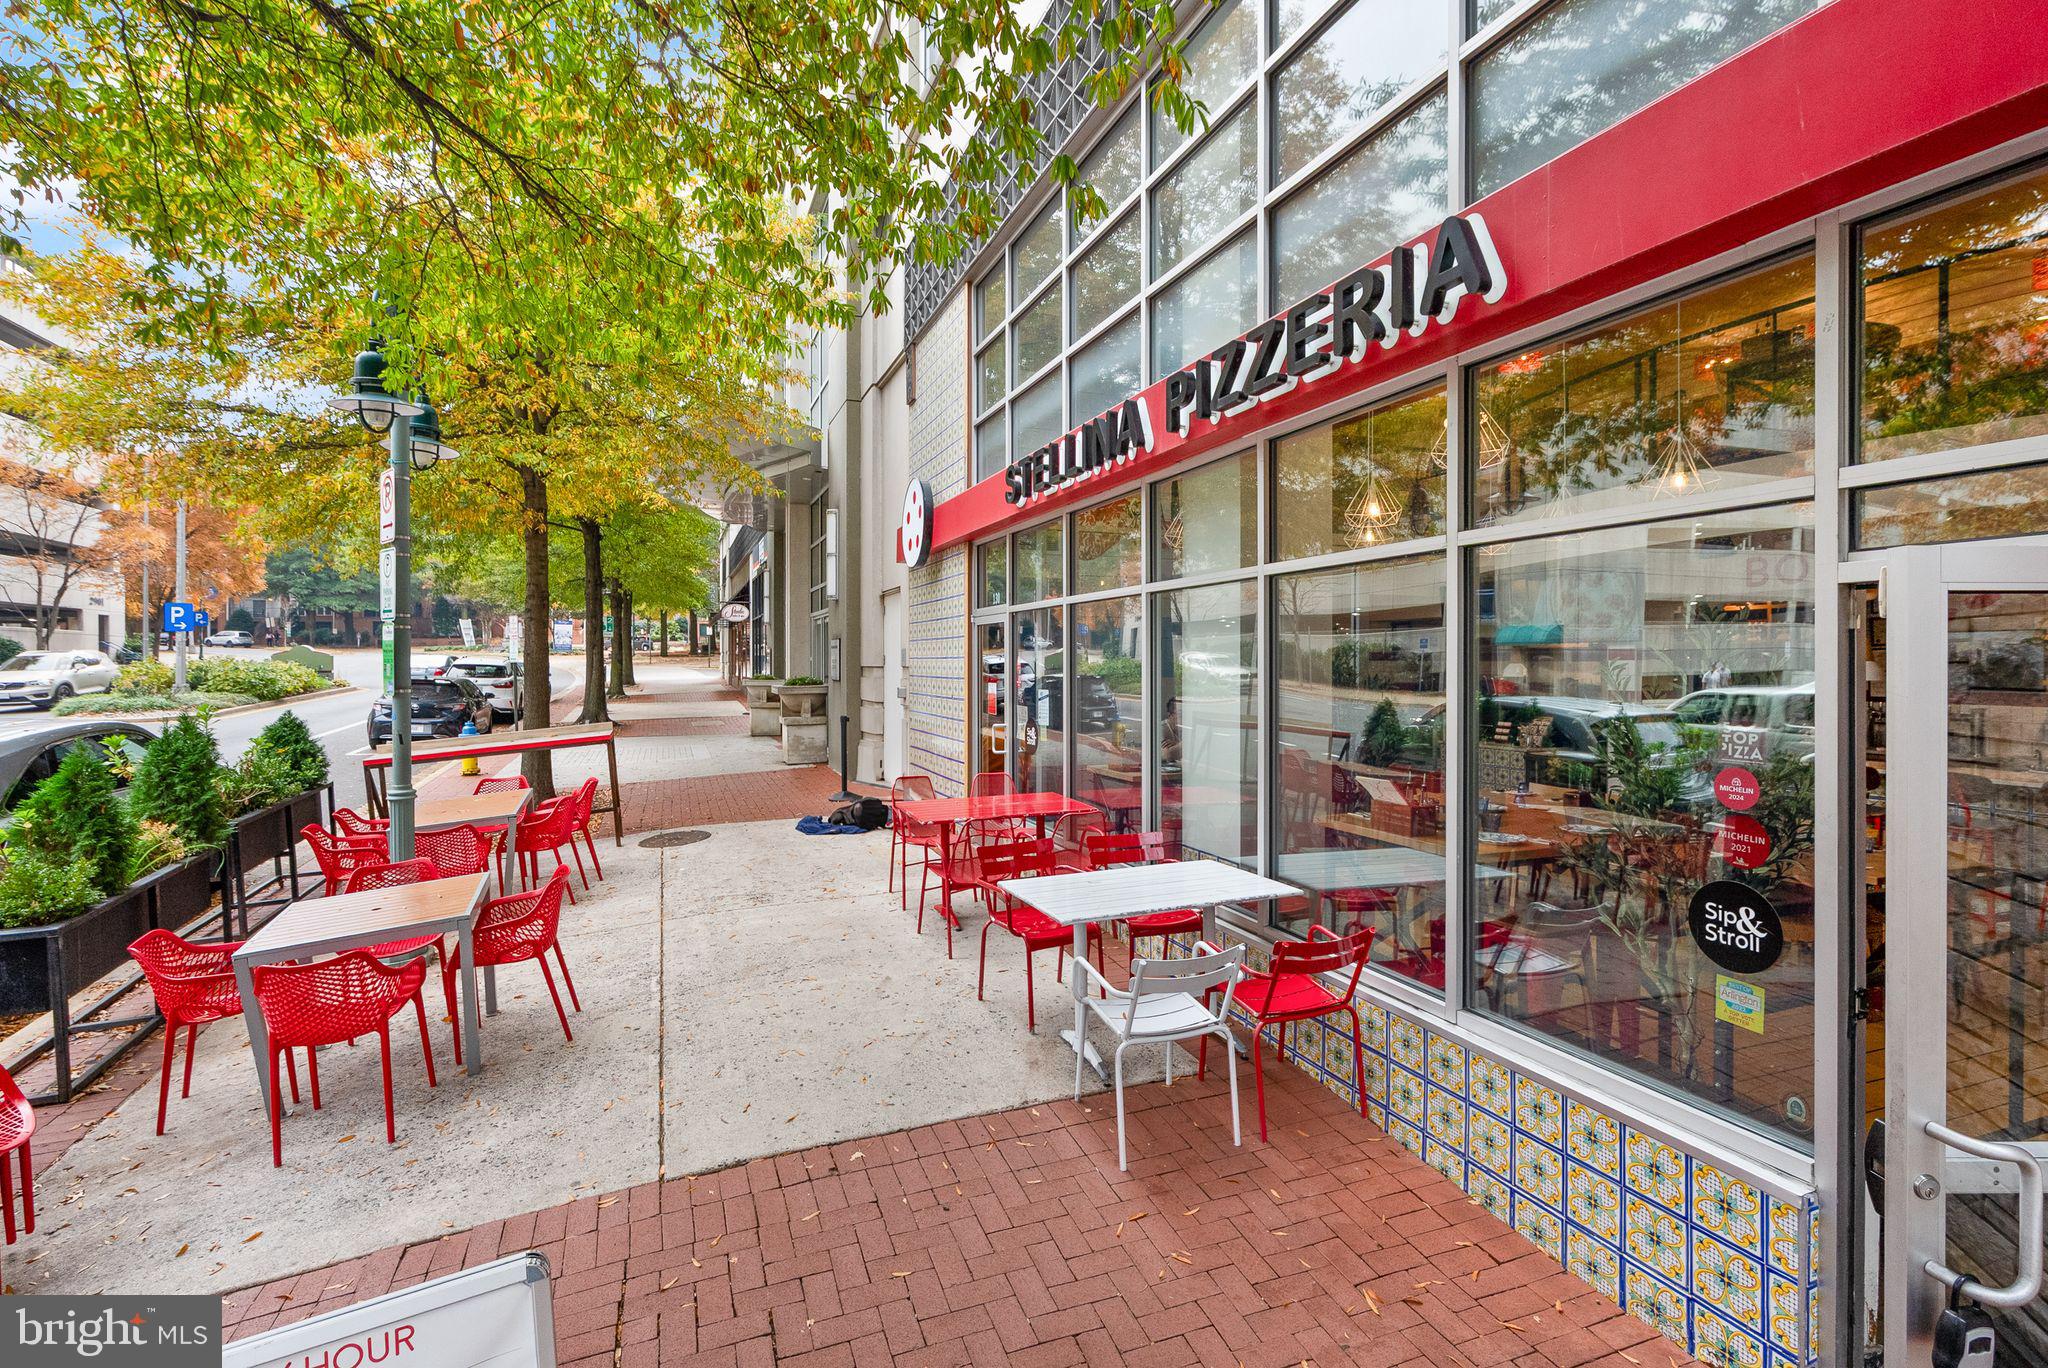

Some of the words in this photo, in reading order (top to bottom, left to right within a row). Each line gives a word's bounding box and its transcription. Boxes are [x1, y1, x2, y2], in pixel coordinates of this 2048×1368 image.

[1004, 396, 1155, 508] STELLINA
[1165, 213, 1508, 438] PIZZERIA
[171, 606, 185, 624] P
[195, 613, 203, 622] P
[1721, 731, 1759, 746] TOP
[1719, 784, 1754, 795] MICHELIN
[1728, 793, 1744, 801] 2024
[1718, 829, 1766, 845] MICHELIN
[1731, 842, 1752, 854] 2021
[1704, 922, 1760, 953] Stroll
[1720, 987, 1760, 1009] Arlington
[304, 1324, 416, 1368] HOUR
